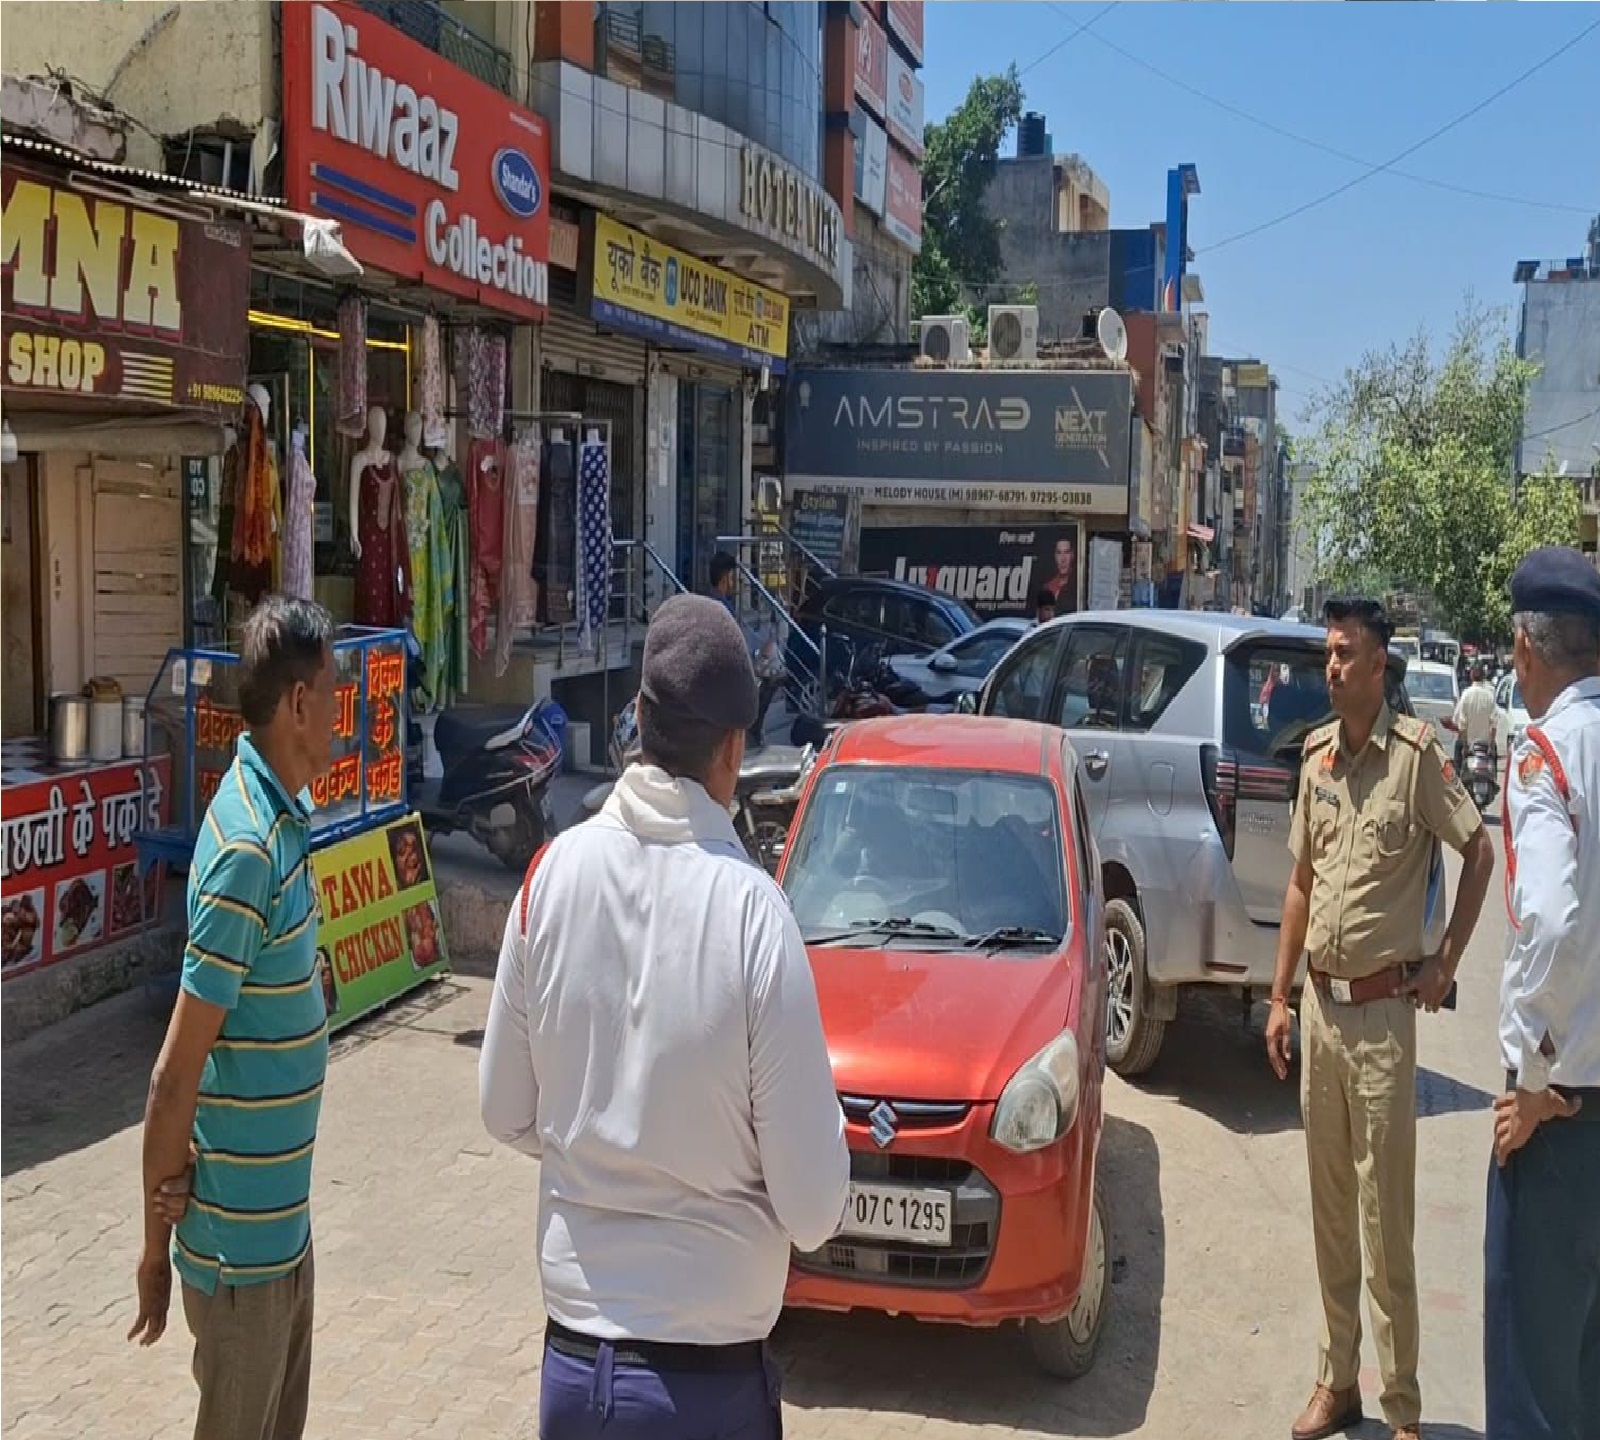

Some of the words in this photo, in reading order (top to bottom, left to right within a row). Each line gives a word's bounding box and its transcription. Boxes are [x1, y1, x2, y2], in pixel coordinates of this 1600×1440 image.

[312, 4, 458, 191] Riwaaz
[424, 199, 548, 306] Collection
[680, 264, 700, 306] UCO
[703, 273, 728, 316] BANK
[8, 331, 105, 392] SHOP
[747, 323, 770, 349] ATM
[834, 395, 1031, 430] AMSTRAD
[1055, 410, 1107, 432] NEXT
[857, 439, 918, 453] INSPIRED
[924, 441, 939, 453] BY
[944, 441, 1003, 454] PASSION
[874, 486, 913, 499] MELODY
[914, 487, 947, 500] HOUSE
[948, 487, 963, 501] (M)
[72, 780, 96, 855] के
[322, 857, 394, 920] TAWA
[334, 916, 405, 983] CHICKEN
